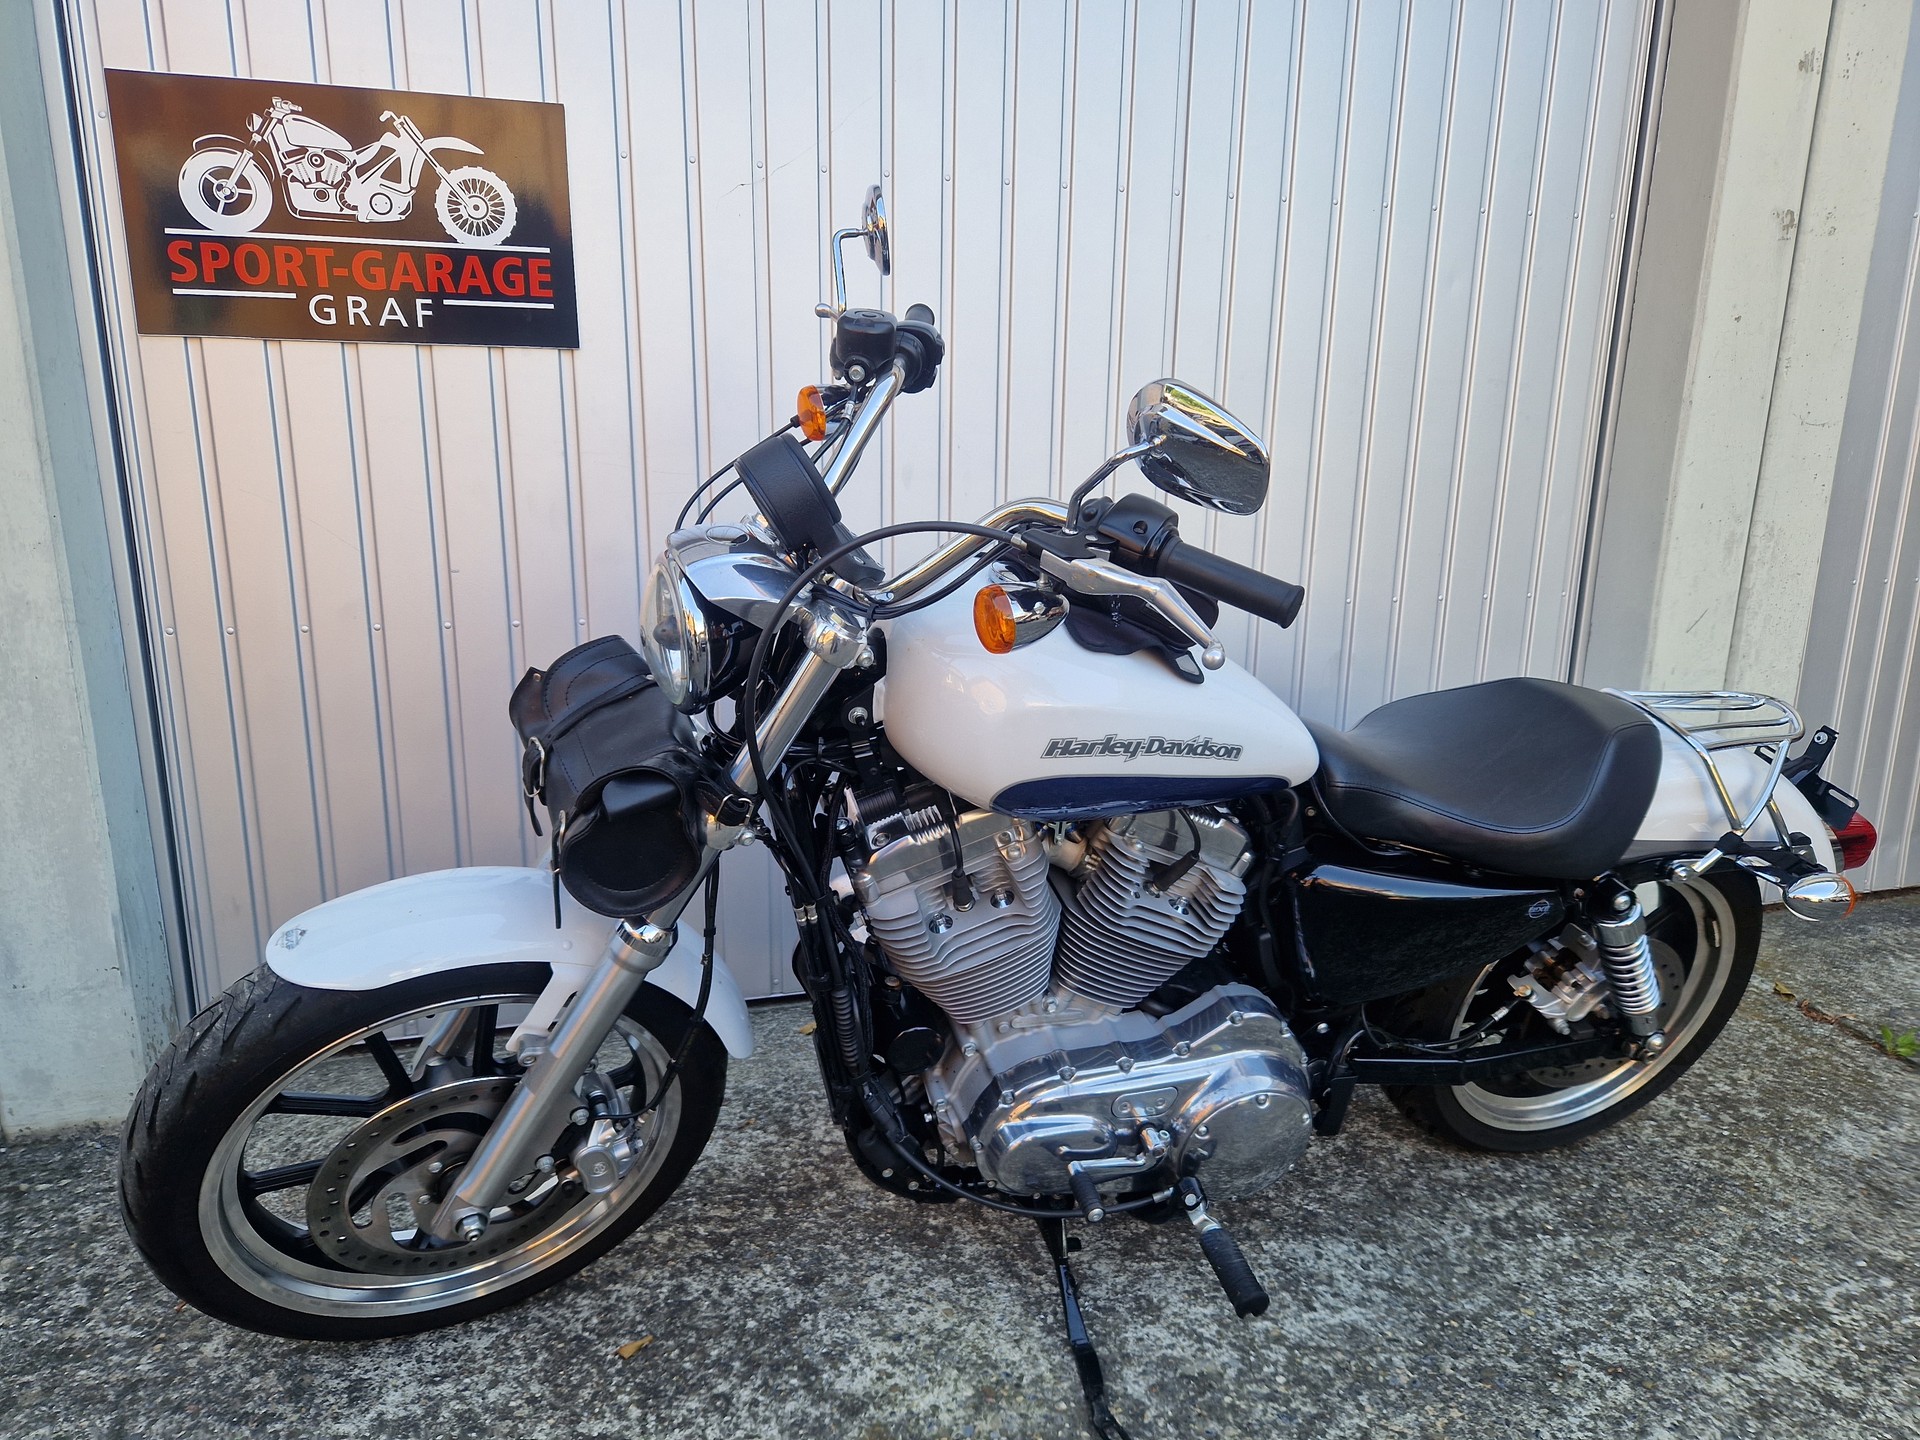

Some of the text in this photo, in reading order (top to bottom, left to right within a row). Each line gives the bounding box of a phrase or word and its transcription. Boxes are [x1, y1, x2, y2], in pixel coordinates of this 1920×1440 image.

[167, 240, 553, 297] SPORT-GARAGE
[308, 294, 433, 328] GRAF
[1040, 734, 1243, 762] Harley-Davidson
